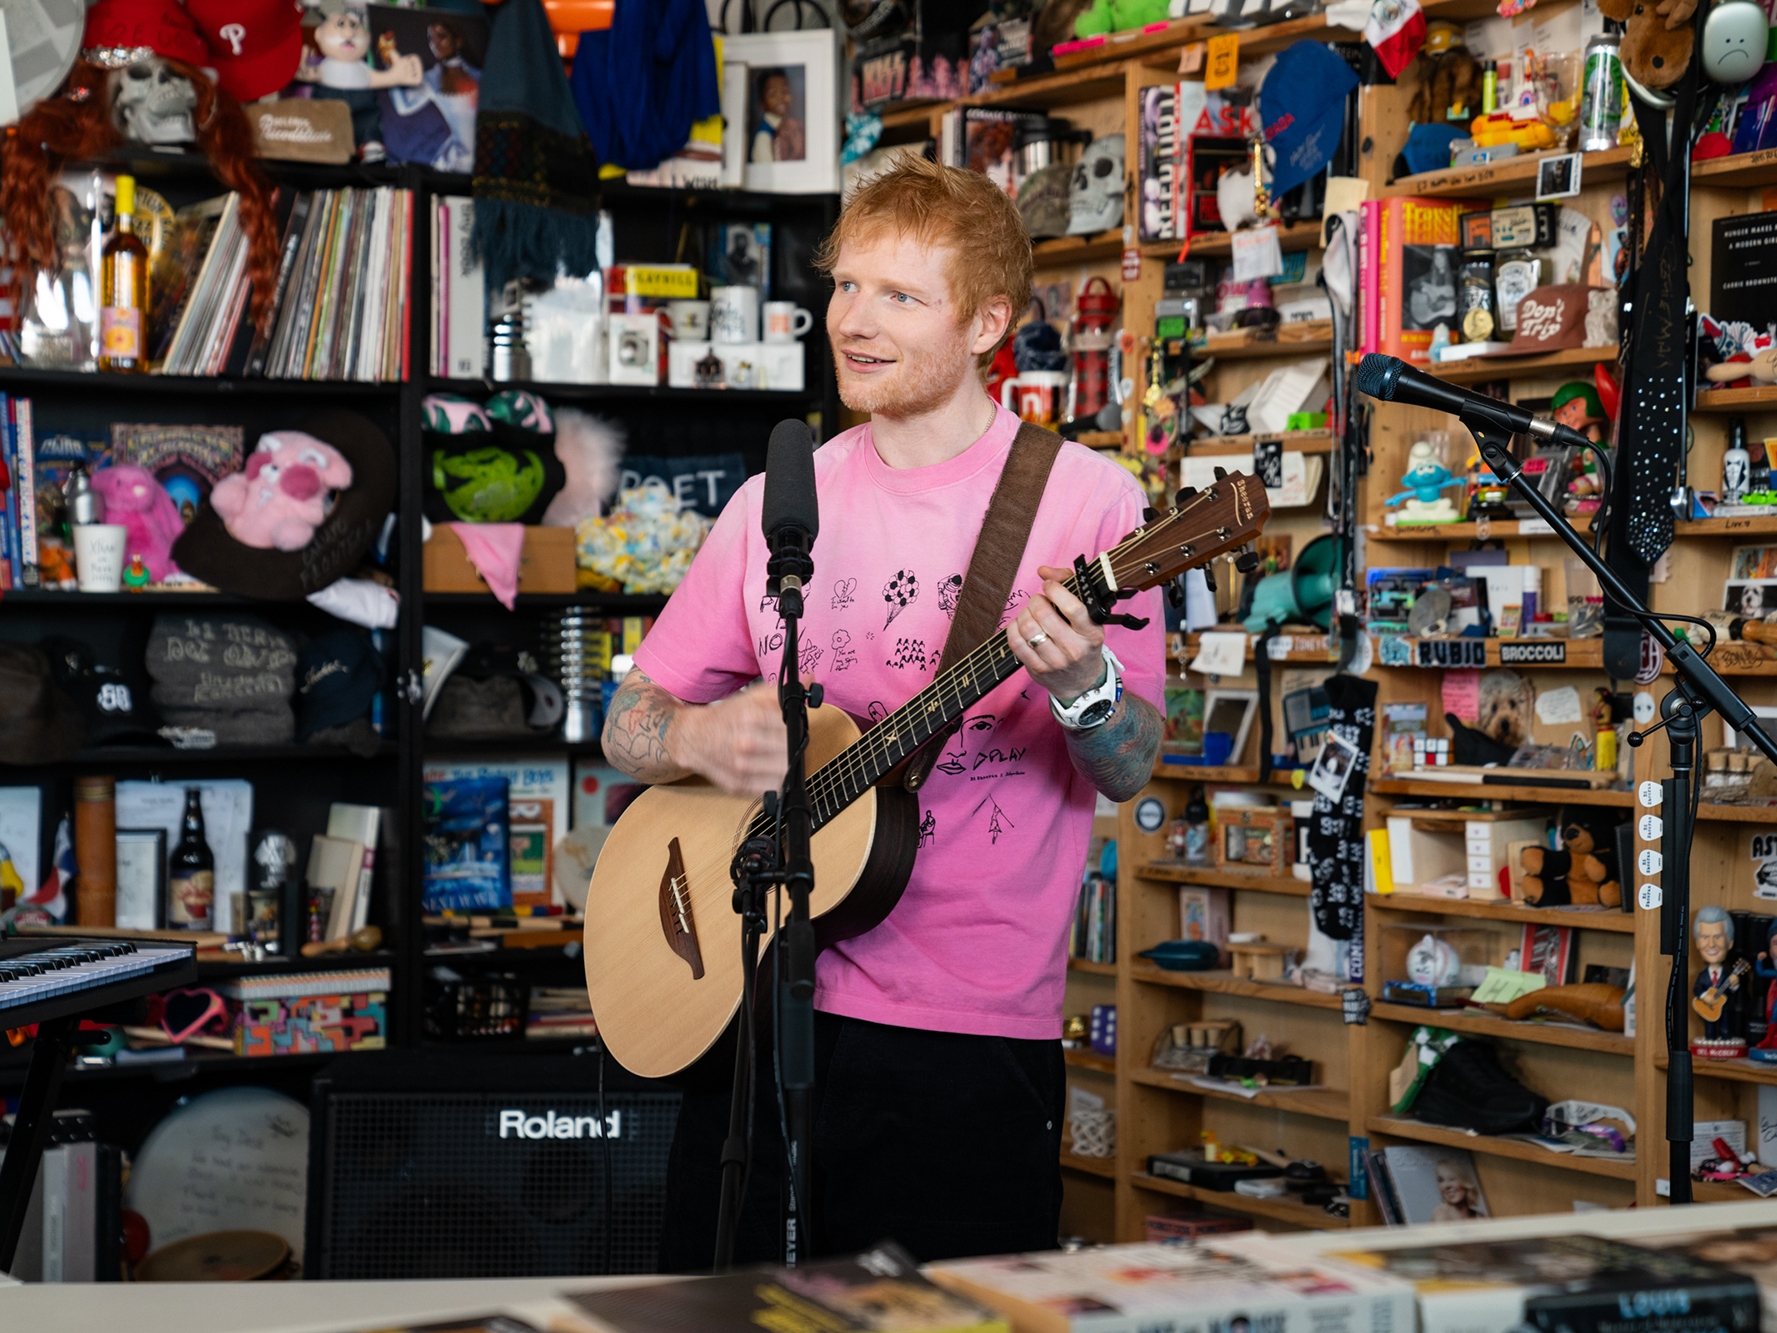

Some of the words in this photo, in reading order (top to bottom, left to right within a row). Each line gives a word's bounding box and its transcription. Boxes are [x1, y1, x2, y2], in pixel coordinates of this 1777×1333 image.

[1194, 107, 1255, 133] ASK
[1751, 224, 1773, 234] MAKES
[1735, 239, 1762, 249] MODERN
[1520, 298, 1565, 323] Don't
[1520, 318, 1562, 341] Trip
[1236, 479, 1254, 520] Sheeran
[1418, 641, 1487, 667] RUBIO
[1502, 645, 1564, 661] BROCCOLI
[988, 747, 1027, 763] PLAY
[500, 1110, 621, 1139] Roland
